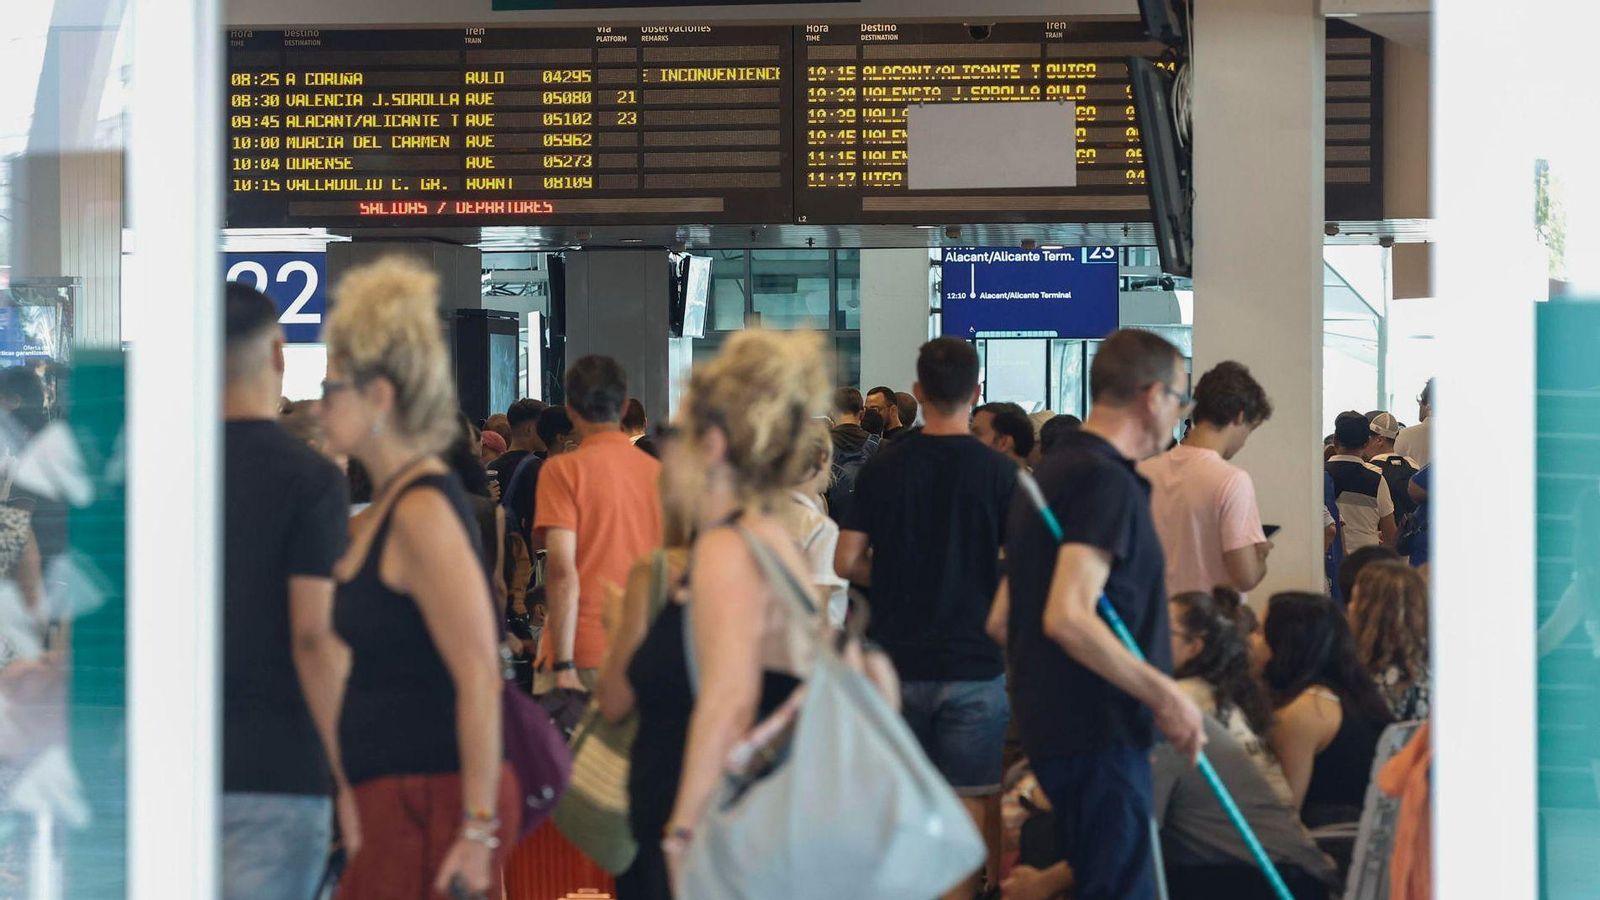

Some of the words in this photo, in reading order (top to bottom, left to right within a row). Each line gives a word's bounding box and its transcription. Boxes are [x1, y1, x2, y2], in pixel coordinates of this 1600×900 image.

[806, 24, 829, 32] Hora
[232, 73, 280, 86] 08:25
[286, 73, 296, 86] A
[304, 73, 363, 86] CORUÑA
[466, 72, 504, 84] AVLO
[543, 70, 592, 84] 04295
[808, 66, 856, 80] 10:15
[232, 94, 280, 107] 08:30
[286, 94, 363, 107] VALENCIA
[372, 94, 460, 107] J.SOROLLA
[466, 93, 494, 106] AVE
[543, 92, 592, 104] 05080
[617, 91, 637, 104] 21
[232, 115, 280, 128] 09:45
[286, 115, 440, 128] ALACANT/ALICANTE
[450, 115, 458, 128] T
[466, 114, 494, 126] AVE
[543, 112, 592, 126] 05102
[617, 112, 637, 124] 23
[232, 137, 280, 150] 10:00
[286, 136, 344, 149] MURCIA
[353, 136, 382, 149] DEL
[392, 136, 450, 149] CARMEN
[466, 135, 494, 148] AVE
[543, 134, 592, 147] 05962
[808, 130, 856, 144] 10:45
[232, 158, 280, 170] 10:04
[286, 157, 354, 170] OURENSE
[466, 156, 494, 168] AVE
[543, 156, 592, 168] 05273
[945, 250, 1040, 265] Alacant/Alicante
[1042, 251, 1074, 262] Term.
[980, 292, 1039, 300] Alacant/Alicante
